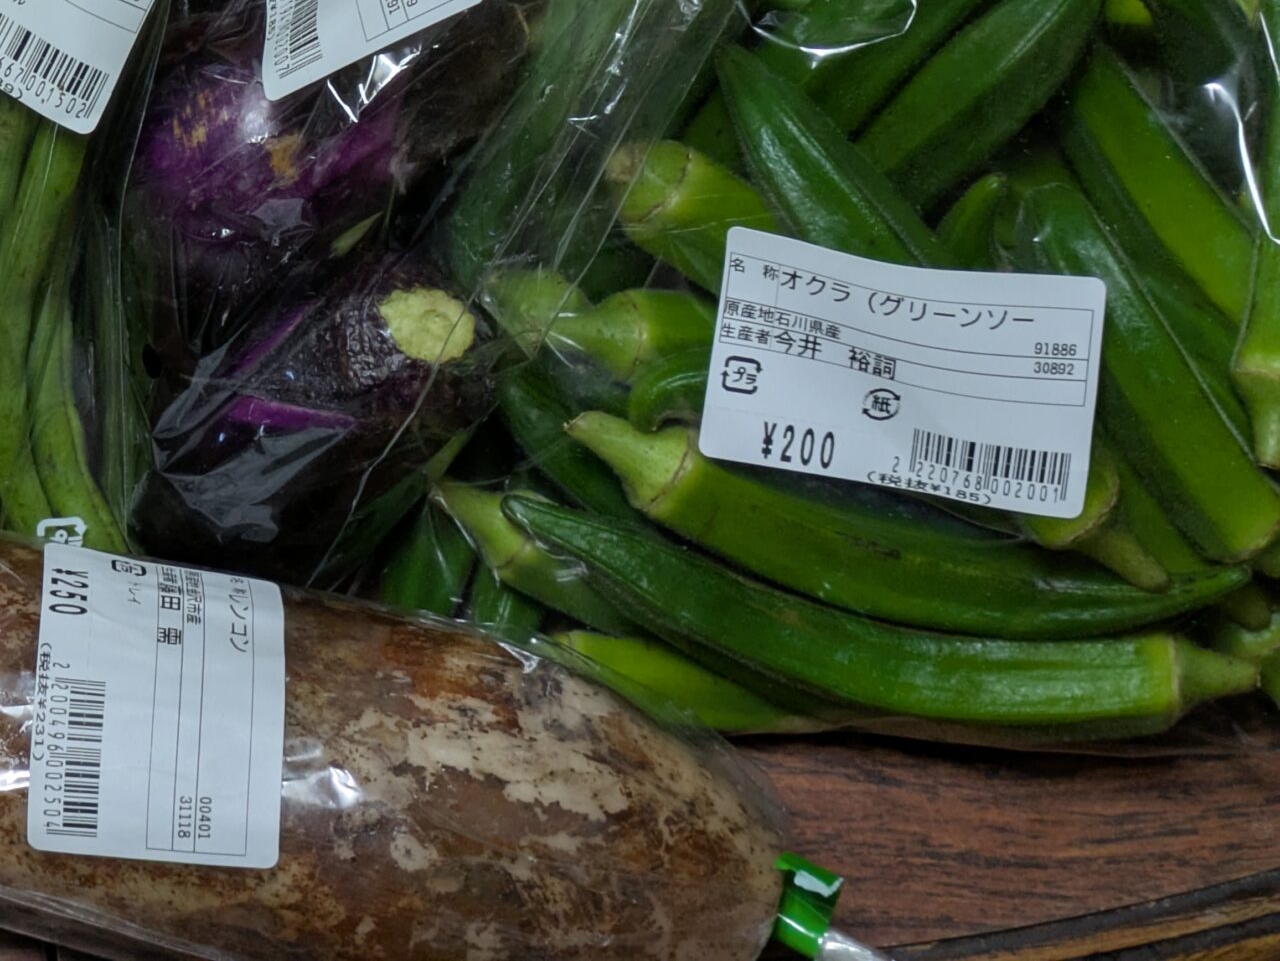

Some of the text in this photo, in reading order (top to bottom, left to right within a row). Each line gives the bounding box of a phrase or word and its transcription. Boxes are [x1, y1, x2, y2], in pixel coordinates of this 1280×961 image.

[725, 300, 841, 339] 原産地 石川県産
[720, 323, 897, 381] 生産者 今井 裕詞
[1033, 361, 1075, 377] 30892
[1034, 341, 1078, 357] 91886
[761, 421, 835, 470] ¥200
[48, 567, 89, 615] ¥250
[229, 593, 250, 653] レンコン
[177, 795, 193, 839] 31118
[197, 795, 211, 840] 00401
